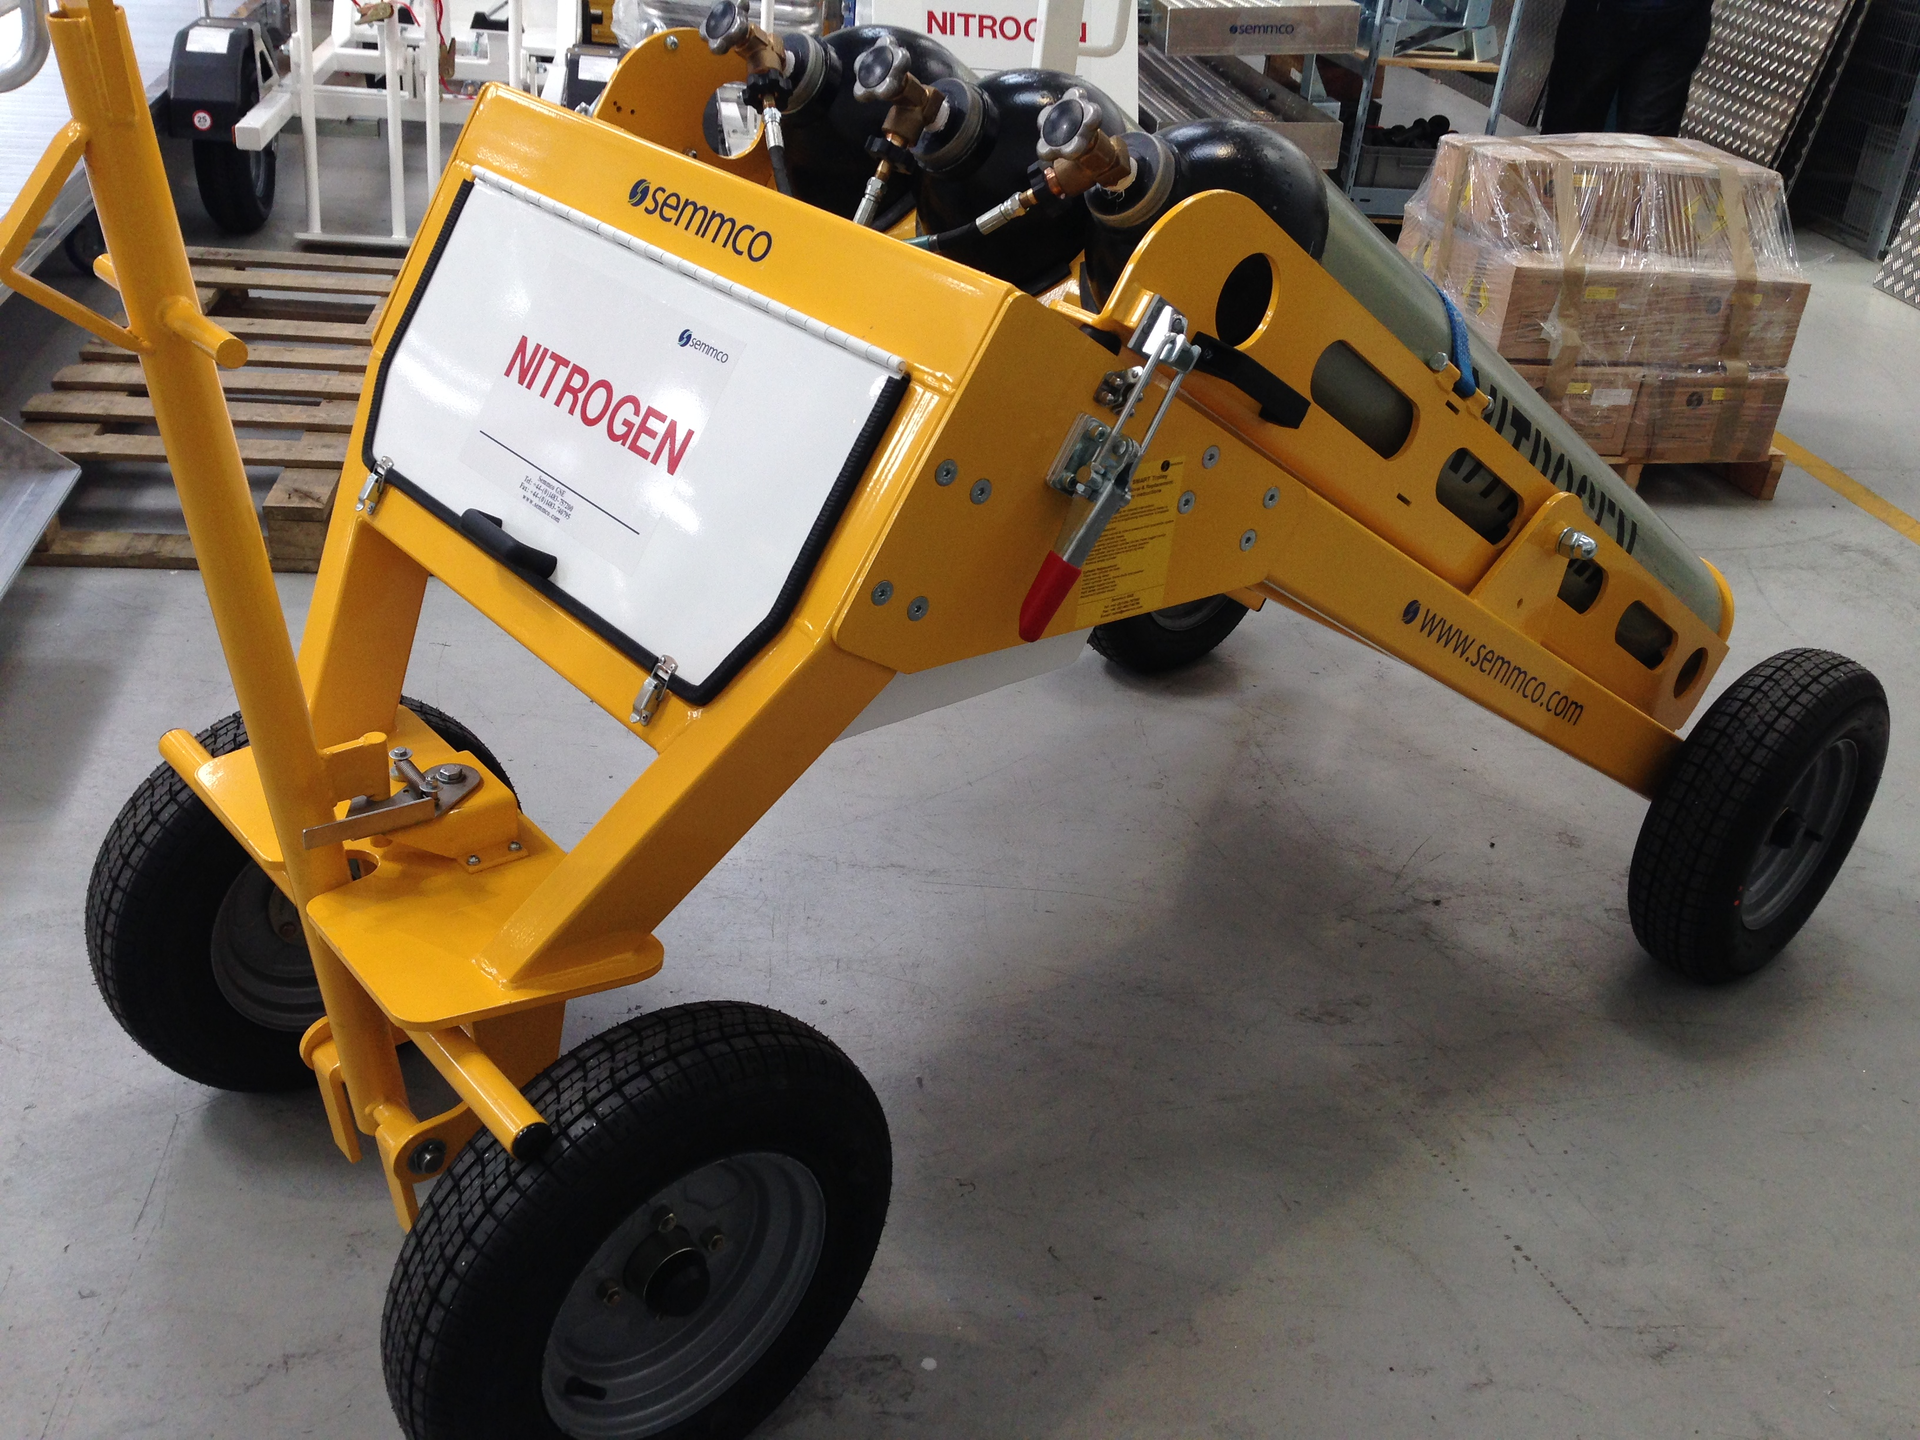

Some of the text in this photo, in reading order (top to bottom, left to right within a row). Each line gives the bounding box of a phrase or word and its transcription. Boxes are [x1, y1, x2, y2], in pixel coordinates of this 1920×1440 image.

[1238, 23, 1295, 35] semmco
[196, 115, 208, 124] 25
[644, 186, 773, 263] semmco
[689, 336, 729, 364] semmco
[504, 335, 695, 477] NITROGEN
[1420, 608, 1585, 727] www.semmco.com
